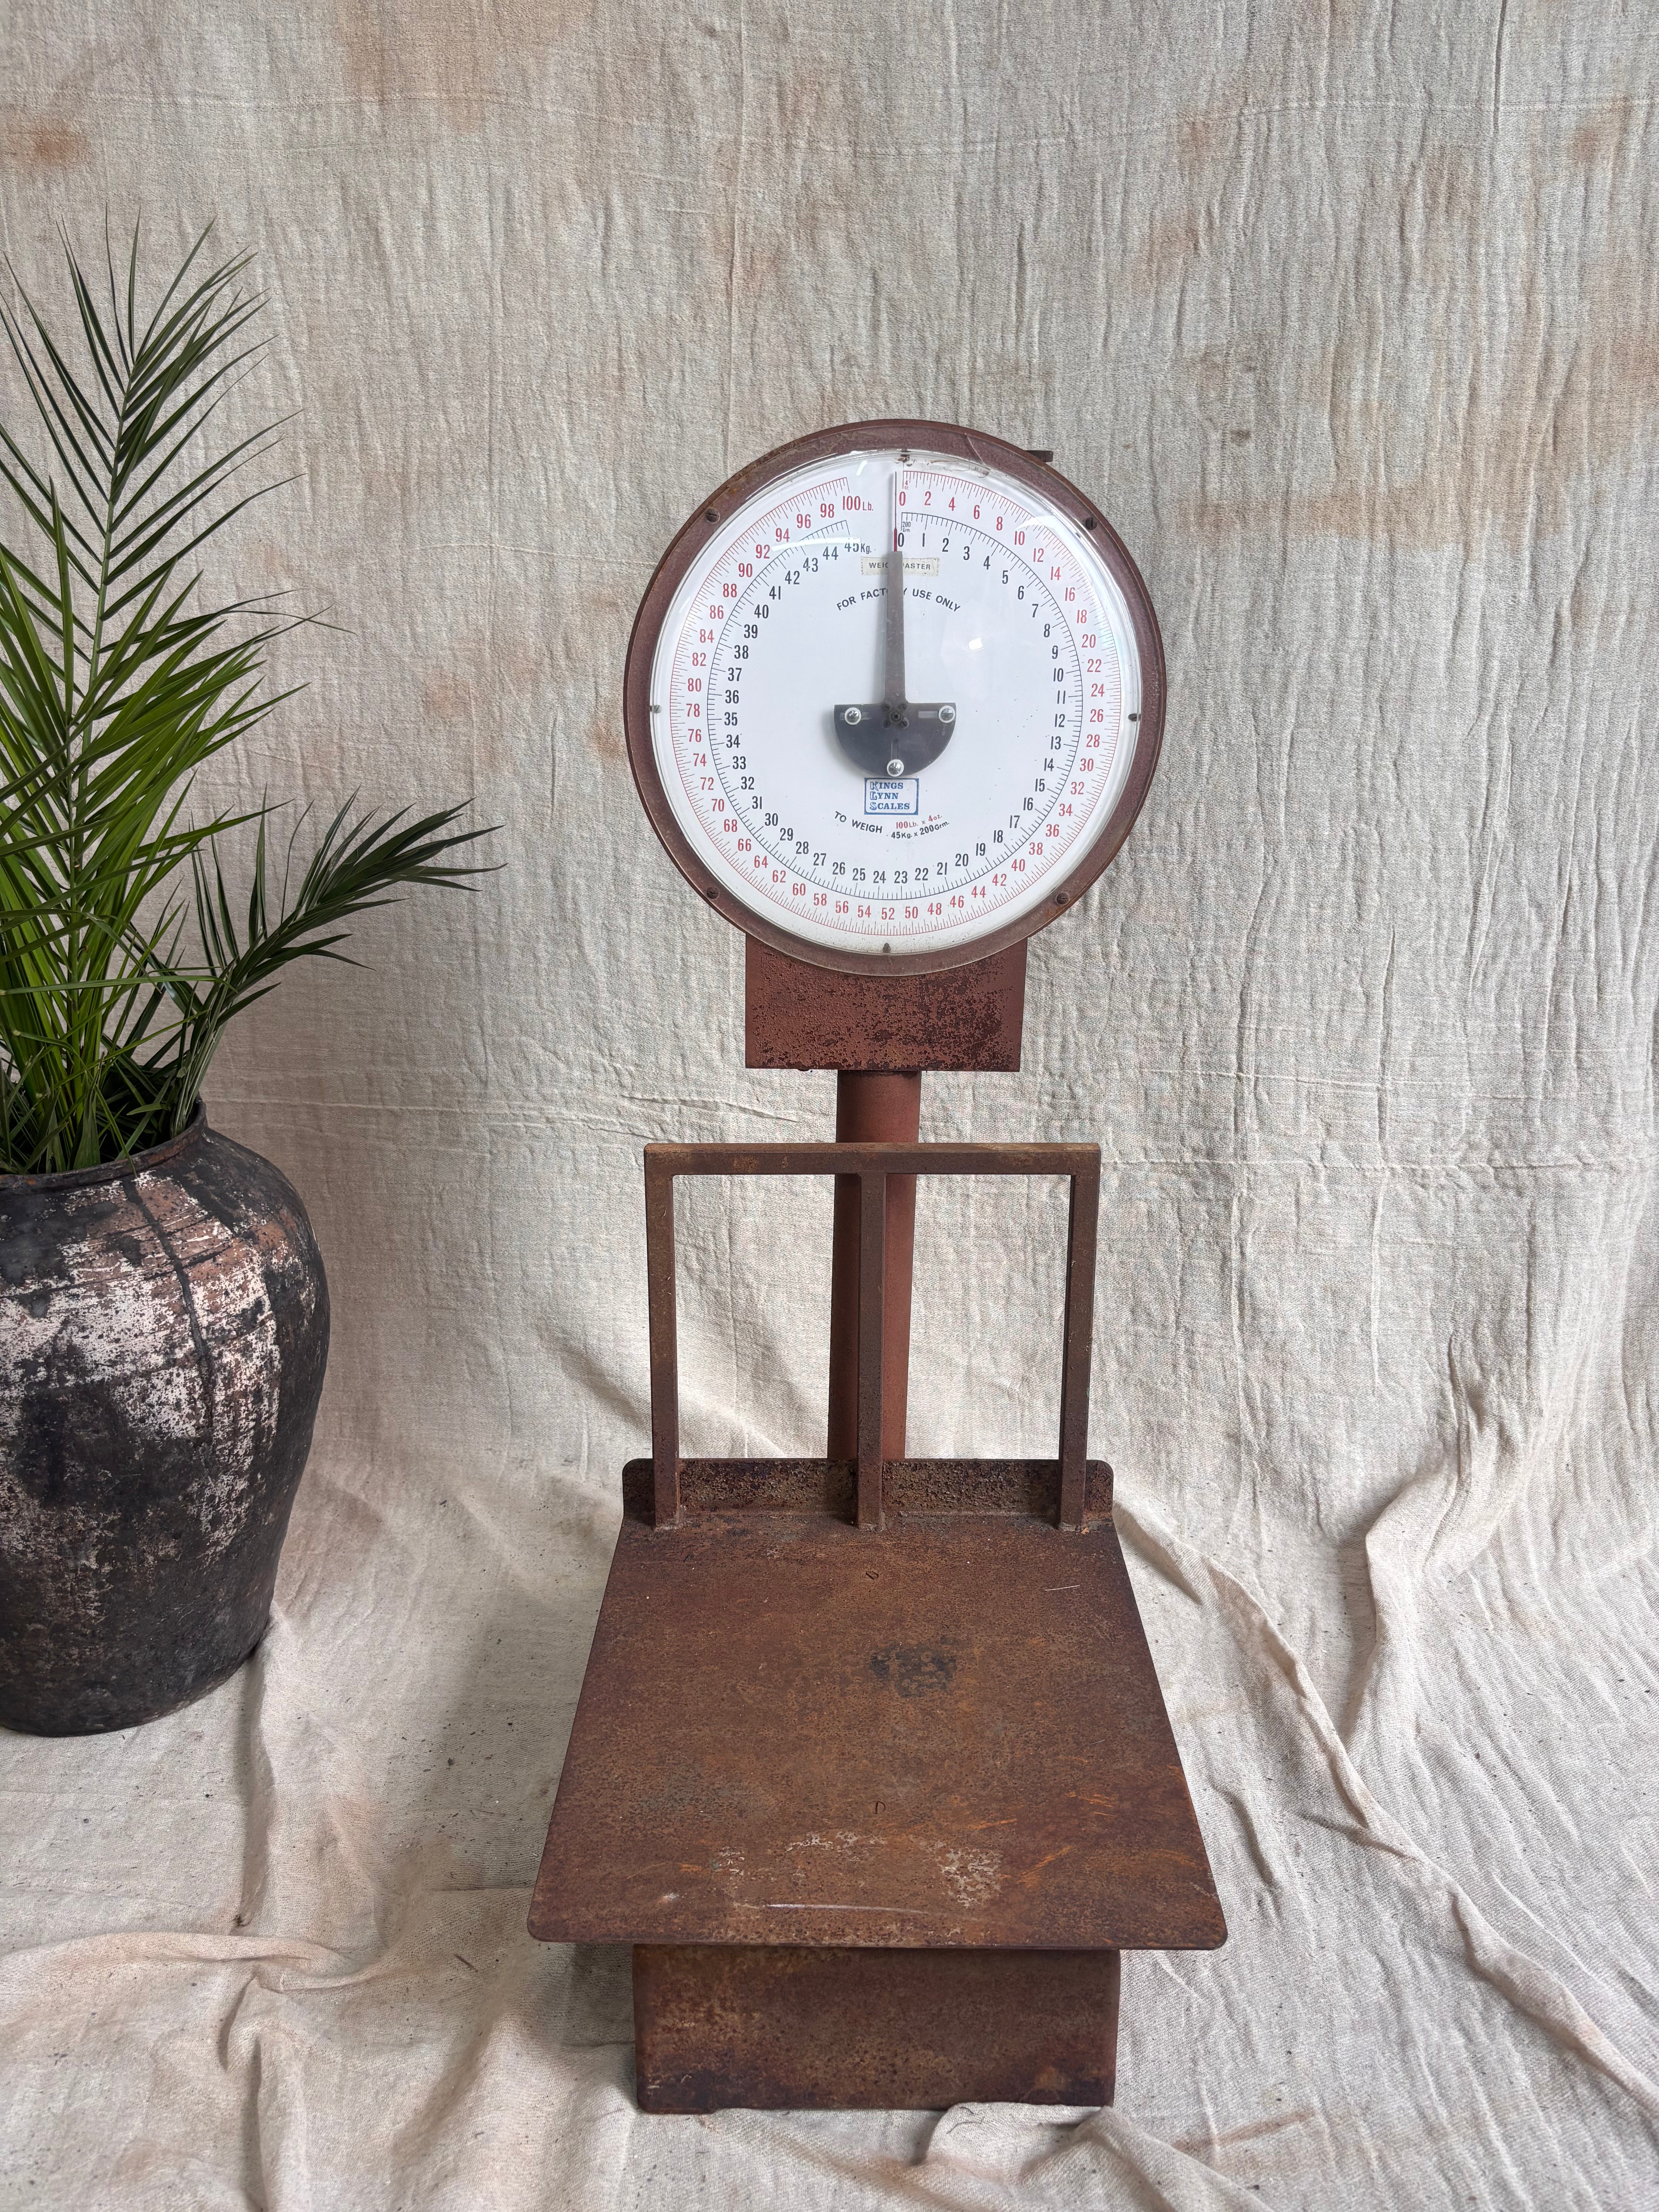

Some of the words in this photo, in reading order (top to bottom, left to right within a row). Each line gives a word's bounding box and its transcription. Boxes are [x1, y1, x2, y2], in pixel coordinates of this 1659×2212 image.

[899, 491, 905, 506] 0
[924, 491, 931, 505] 2
[949, 497, 955, 511] 4
[820, 503, 834, 518] 98
[974, 505, 980, 519] 6
[797, 514, 811, 528] 96
[996, 517, 1003, 531] 8
[776, 528, 790, 542] 94
[898, 532, 904, 547] 0
[922, 533, 925, 547] 1
[1015, 531, 1025, 545] 10
[756, 544, 770, 559] 92
[942, 538, 949, 552] 2
[823, 546, 838, 560] 44
[963, 546, 970, 560] 3
[1034, 548, 1044, 562] 12
[803, 558, 818, 572] 43
[984, 556, 990, 570] 4
[738, 563, 752, 577] 90
[1051, 567, 1061, 580] 14
[785, 570, 800, 584] 42
[1002, 570, 1008, 584] 5
[723, 583, 737, 598] 88
[769, 586, 781, 600] 41
[1018, 586, 1024, 599] 6
[1065, 587, 1075, 601] 16
[836, 596, 857, 611] FOR
[860, 588, 907, 600] FACTY
[912, 589, 932, 600] USE
[936, 595, 961, 612] ONLY
[710, 605, 723, 619] 86
[754, 605, 769, 618] 40
[1032, 604, 1039, 618] 7
[1077, 610, 1087, 623] 18
[700, 629, 714, 643] 84
[744, 624, 757, 639] 39
[1044, 623, 1050, 637] 8
[1082, 634, 1096, 648] 20
[734, 645, 749, 659] 38
[1052, 646, 1058, 659] 9
[692, 653, 706, 666] 82
[1087, 659, 1101, 672] 22
[728, 667, 742, 681] 37
[1053, 668, 1063, 682] 10
[688, 678, 701, 692] 80
[1091, 684, 1104, 697] 24
[725, 690, 739, 704] 36
[1057, 690, 1066, 704] 11
[686, 704, 700, 717] 78
[1090, 709, 1103, 722] 26
[724, 712, 737, 726] 35
[1054, 714, 1065, 727] 12
[688, 729, 701, 742] 76
[726, 734, 740, 748] 34
[1086, 734, 1100, 747] 28
[1051, 736, 1061, 750] 13
[693, 753, 707, 766] 74
[733, 756, 746, 769] 33
[1044, 758, 1054, 771] 14
[1080, 758, 1094, 771] 30
[700, 777, 714, 790] 72
[741, 776, 754, 790] 32
[870, 781, 903, 791] KINGS
[1035, 778, 1045, 792] 15
[1071, 782, 1084, 794] 32
[752, 796, 762, 809] 31
[870, 792, 899, 800] LYNN
[711, 799, 724, 812] 70
[869, 802, 910, 810] SCALES
[1023, 797, 1033, 811] 16
[1059, 804, 1073, 816] 34
[724, 819, 737, 832] 68
[765, 813, 778, 826] 30
[835, 811, 847, 823] TO
[852, 819, 883, 833] WEIGH
[1010, 815, 1020, 828] 17
[780, 828, 793, 841] 29
[994, 830, 1003, 843] 18
[1046, 824, 1059, 837] 36
[738, 838, 751, 851] 66
[796, 842, 809, 854] 28
[976, 843, 986, 856] 19
[1029, 842, 1043, 855] 38
[754, 855, 768, 868] 64
[813, 853, 826, 866] 27
[955, 854, 969, 866] 20
[1011, 859, 1025, 871] 40
[833, 862, 845, 875] 26
[852, 868, 866, 881] 25
[915, 868, 928, 881] 22
[937, 862, 947, 875] 21
[773, 870, 786, 883] 62
[873, 871, 886, 883] 24
[894, 871, 907, 884] 23
[992, 874, 1006, 886] 42
[793, 883, 805, 896] 60
[971, 886, 986, 898] 44
[814, 893, 827, 906] 58
[950, 895, 964, 908] 46
[836, 901, 848, 913] 56
[858, 905, 871, 918] 54
[905, 907, 918, 919] 50
[927, 903, 941, 915] 48
[881, 908, 895, 920] 52
